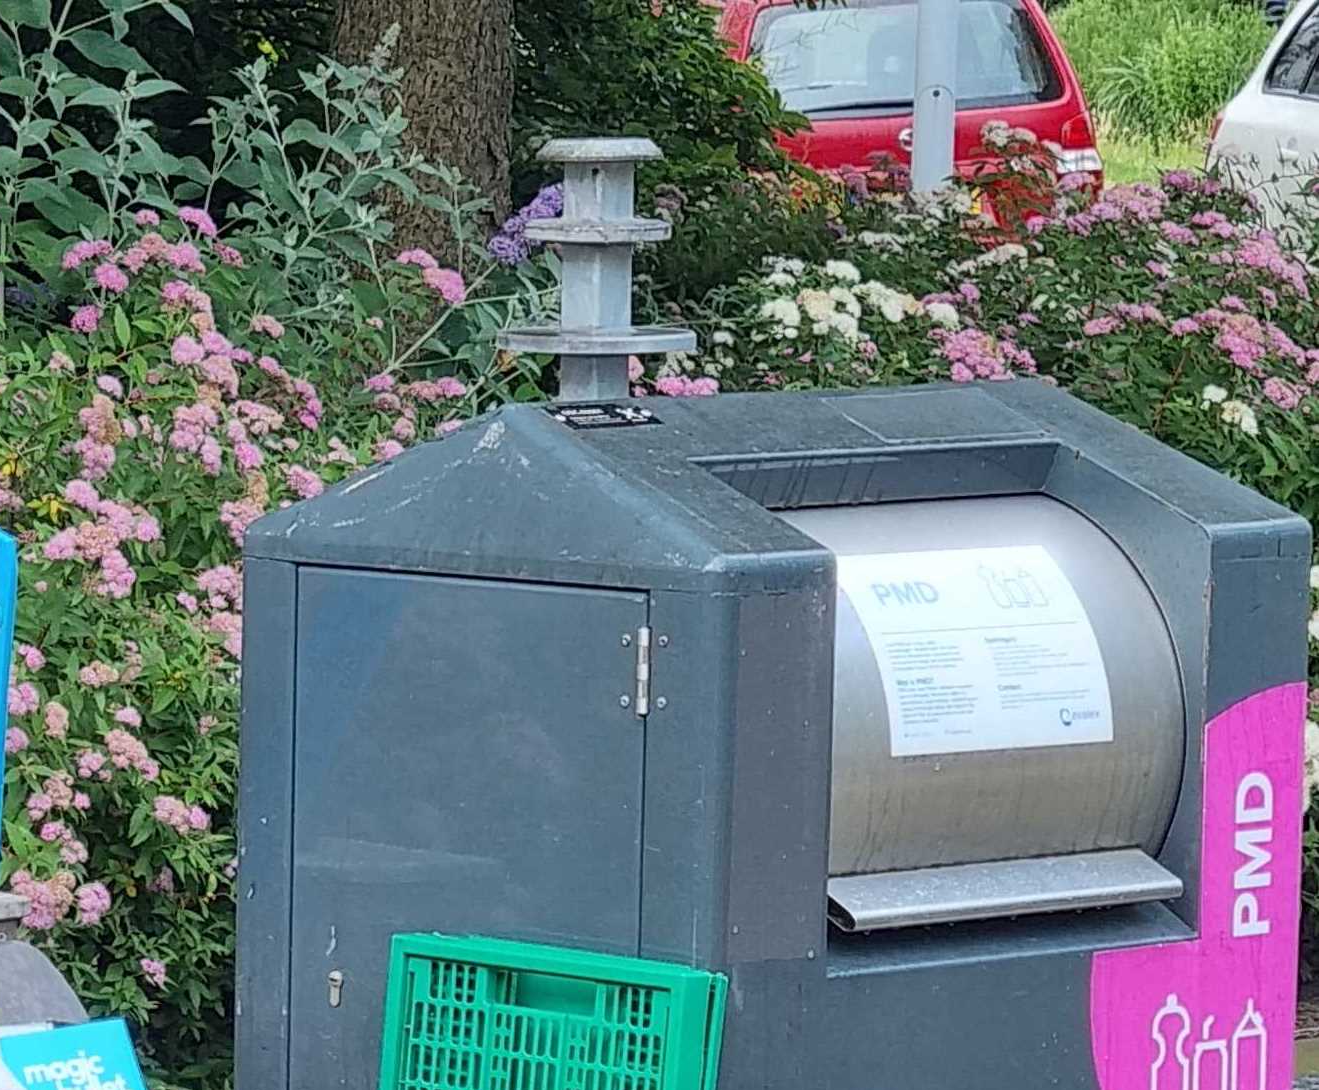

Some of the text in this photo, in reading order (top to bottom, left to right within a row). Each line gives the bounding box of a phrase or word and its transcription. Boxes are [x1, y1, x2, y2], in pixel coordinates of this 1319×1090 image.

[871, 581, 940, 607] PMD
[1233, 771, 1273, 938] PMD
[23, 1049, 104, 1085] magic
